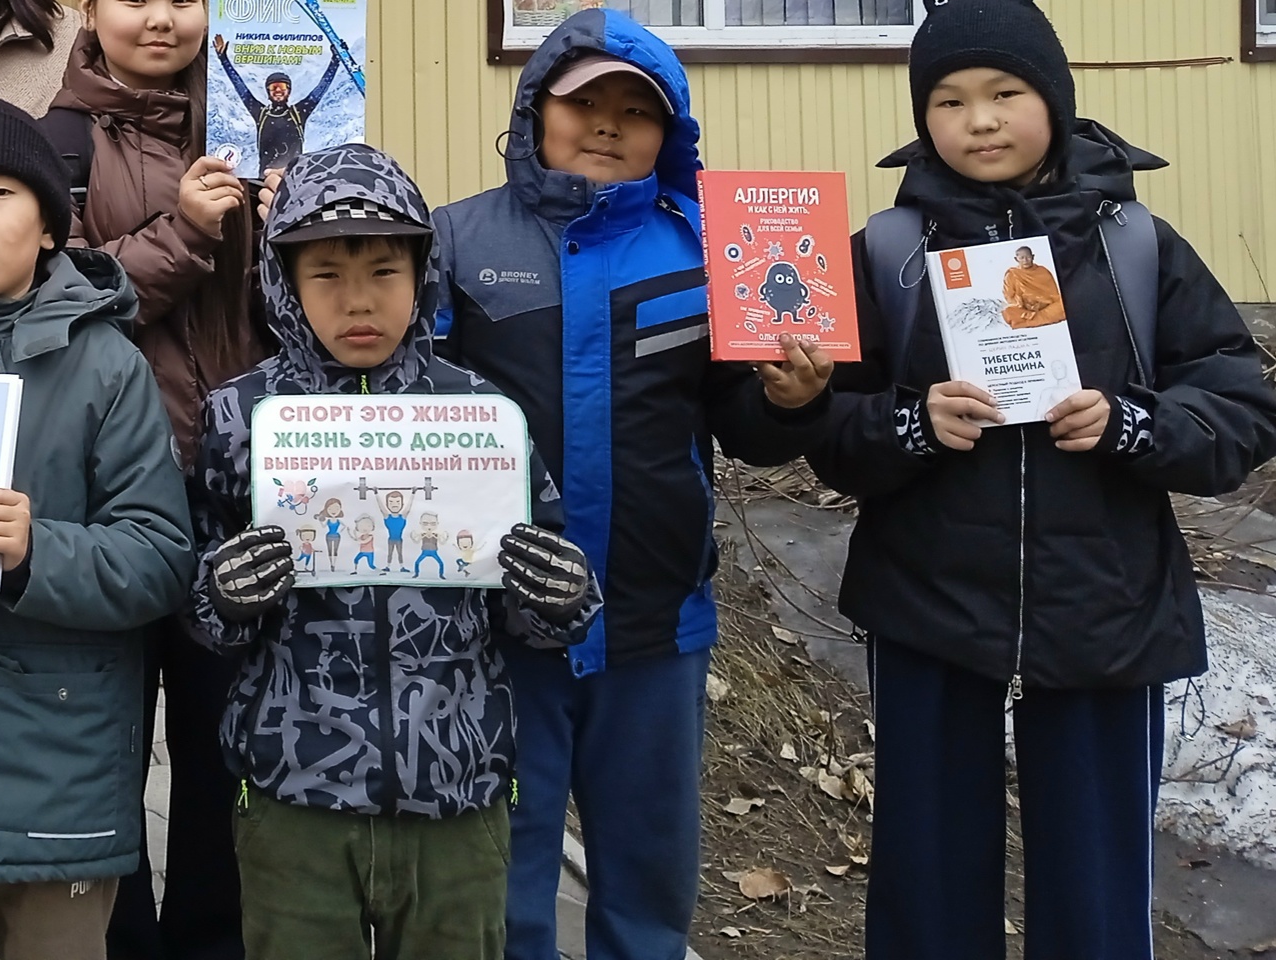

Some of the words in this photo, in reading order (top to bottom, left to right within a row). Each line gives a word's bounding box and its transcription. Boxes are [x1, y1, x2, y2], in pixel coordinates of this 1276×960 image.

[236, 33, 270, 41] НИКИТА
[272, 33, 324, 41] ФИЛИППОВ
[268, 44, 276, 54] К
[278, 45, 323, 55] НОВЫМ
[234, 55, 303, 65] ВЕРШИНАМ!
[733, 187, 820, 206] АЛЛЕРГИЯ
[754, 206, 768, 214] КАК
[773, 205, 787, 214] НЕЙ
[759, 218, 799, 226] РУКОВОДСТВО
[756, 225, 769, 233] ДЛЯ
[770, 224, 784, 232] ВСЕЙ
[500, 271, 539, 279] BRONEY
[982, 350, 1042, 365] ТИБЕТСКАЯ
[985, 361, 1045, 375] МЕДИЦИНА
[279, 405, 353, 422] СПОРТ
[360, 405, 404, 422] ЭТО
[411, 405, 497, 422] ЖИЗНЬ!
[273, 431, 352, 449] ЖИЗНЬ
[358, 431, 402, 449] ЭТО
[410, 431, 504, 451] ДОРОГА.
[263, 456, 333, 471] ВЫБЕРИ
[338, 454, 462, 471] ПРАВИЛЬНЫЙ
[467, 456, 516, 471] ПУТЬ!
